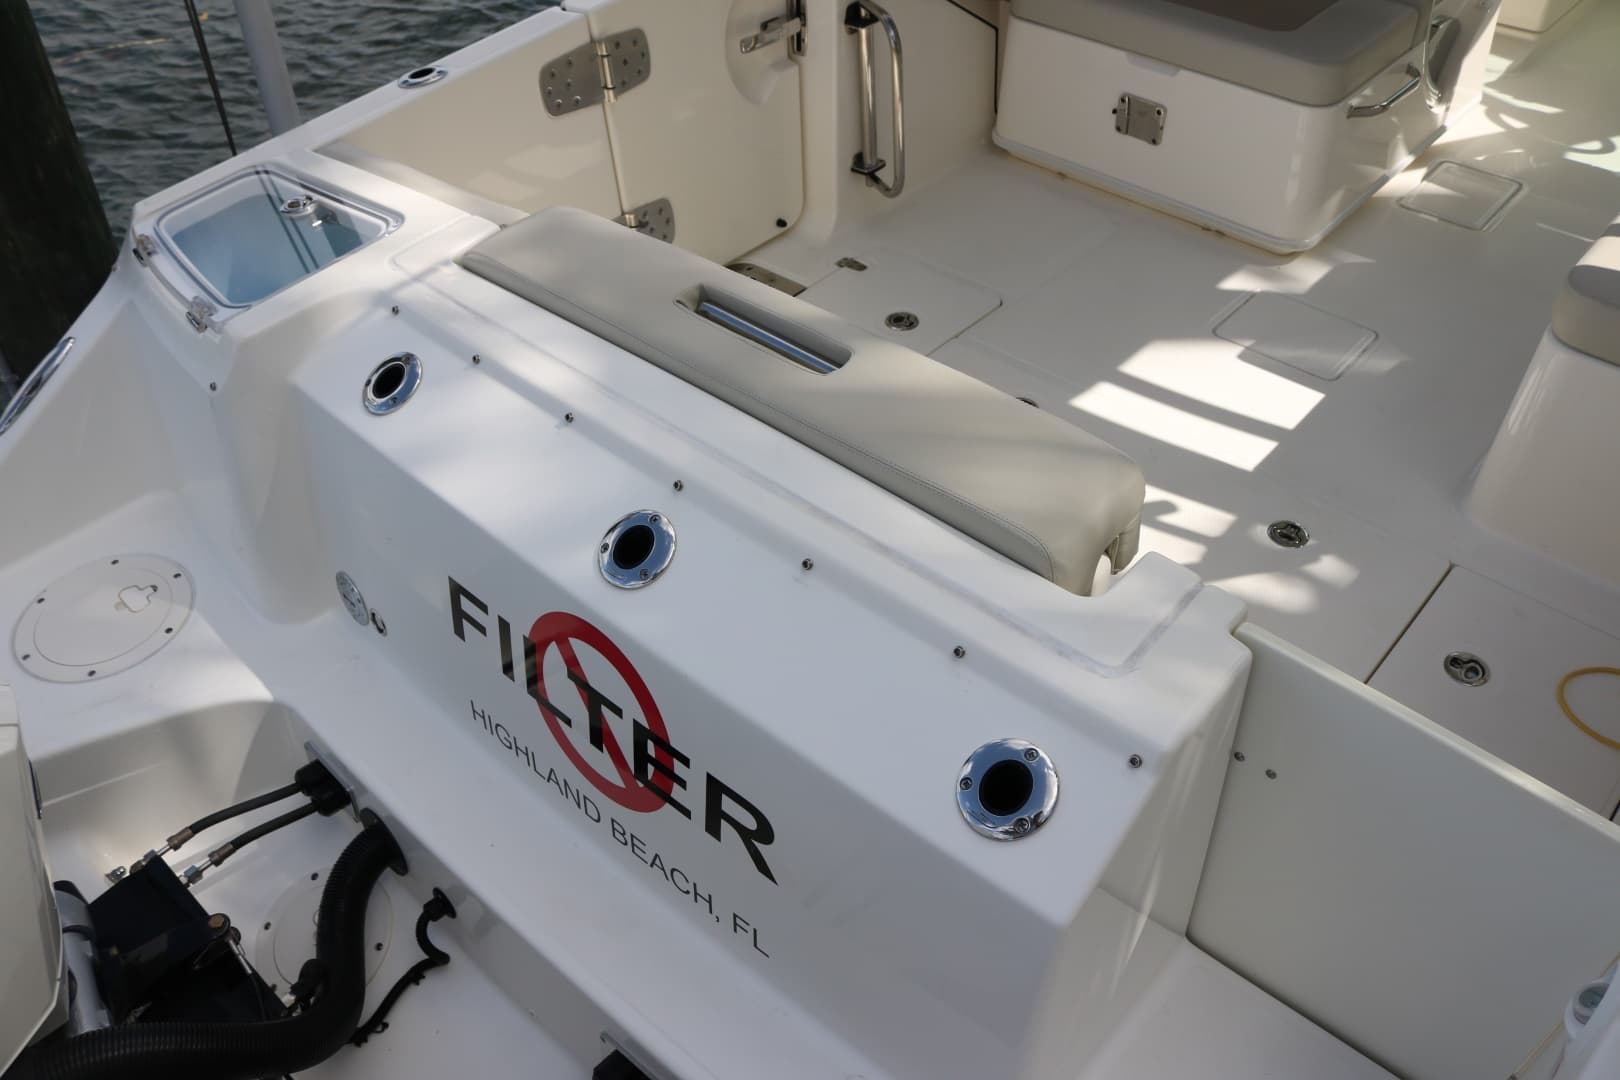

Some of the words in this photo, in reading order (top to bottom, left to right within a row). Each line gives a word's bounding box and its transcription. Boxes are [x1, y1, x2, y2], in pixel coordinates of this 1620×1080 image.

[448, 576, 778, 885] FILTER
[470, 700, 601, 823] HIGHLAND
[610, 817, 720, 922] BEACH,
[732, 912, 770, 958] FL
